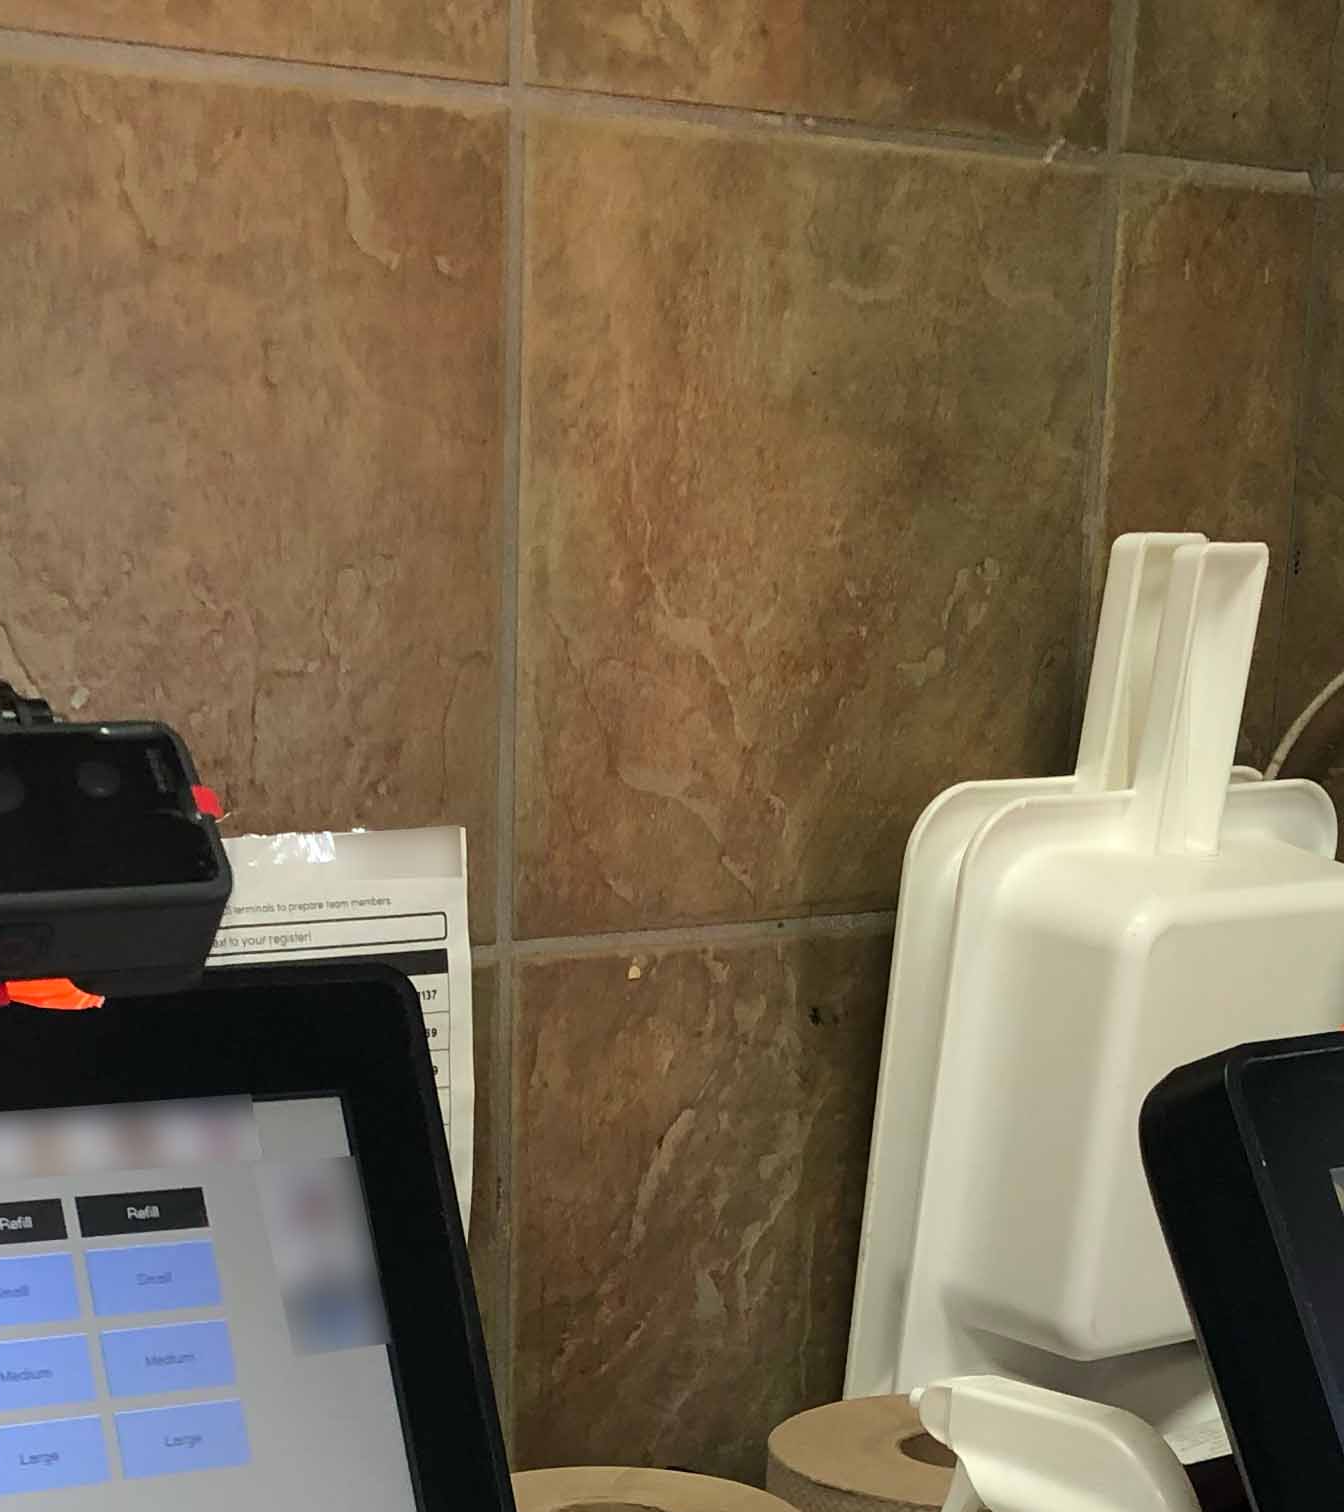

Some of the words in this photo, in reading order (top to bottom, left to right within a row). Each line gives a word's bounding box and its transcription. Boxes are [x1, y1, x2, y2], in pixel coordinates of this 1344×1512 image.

[277, 902, 286, 912] to
[288, 901, 324, 914] prepare
[228, 936, 240, 947] to
[242, 935, 266, 948] your
[126, 1203, 160, 1223] Refill
[145, 1349, 195, 1368] Medium
[0, 1364, 53, 1384] Medium
[164, 1431, 203, 1451] Large
[19, 1448, 60, 1469] Large
